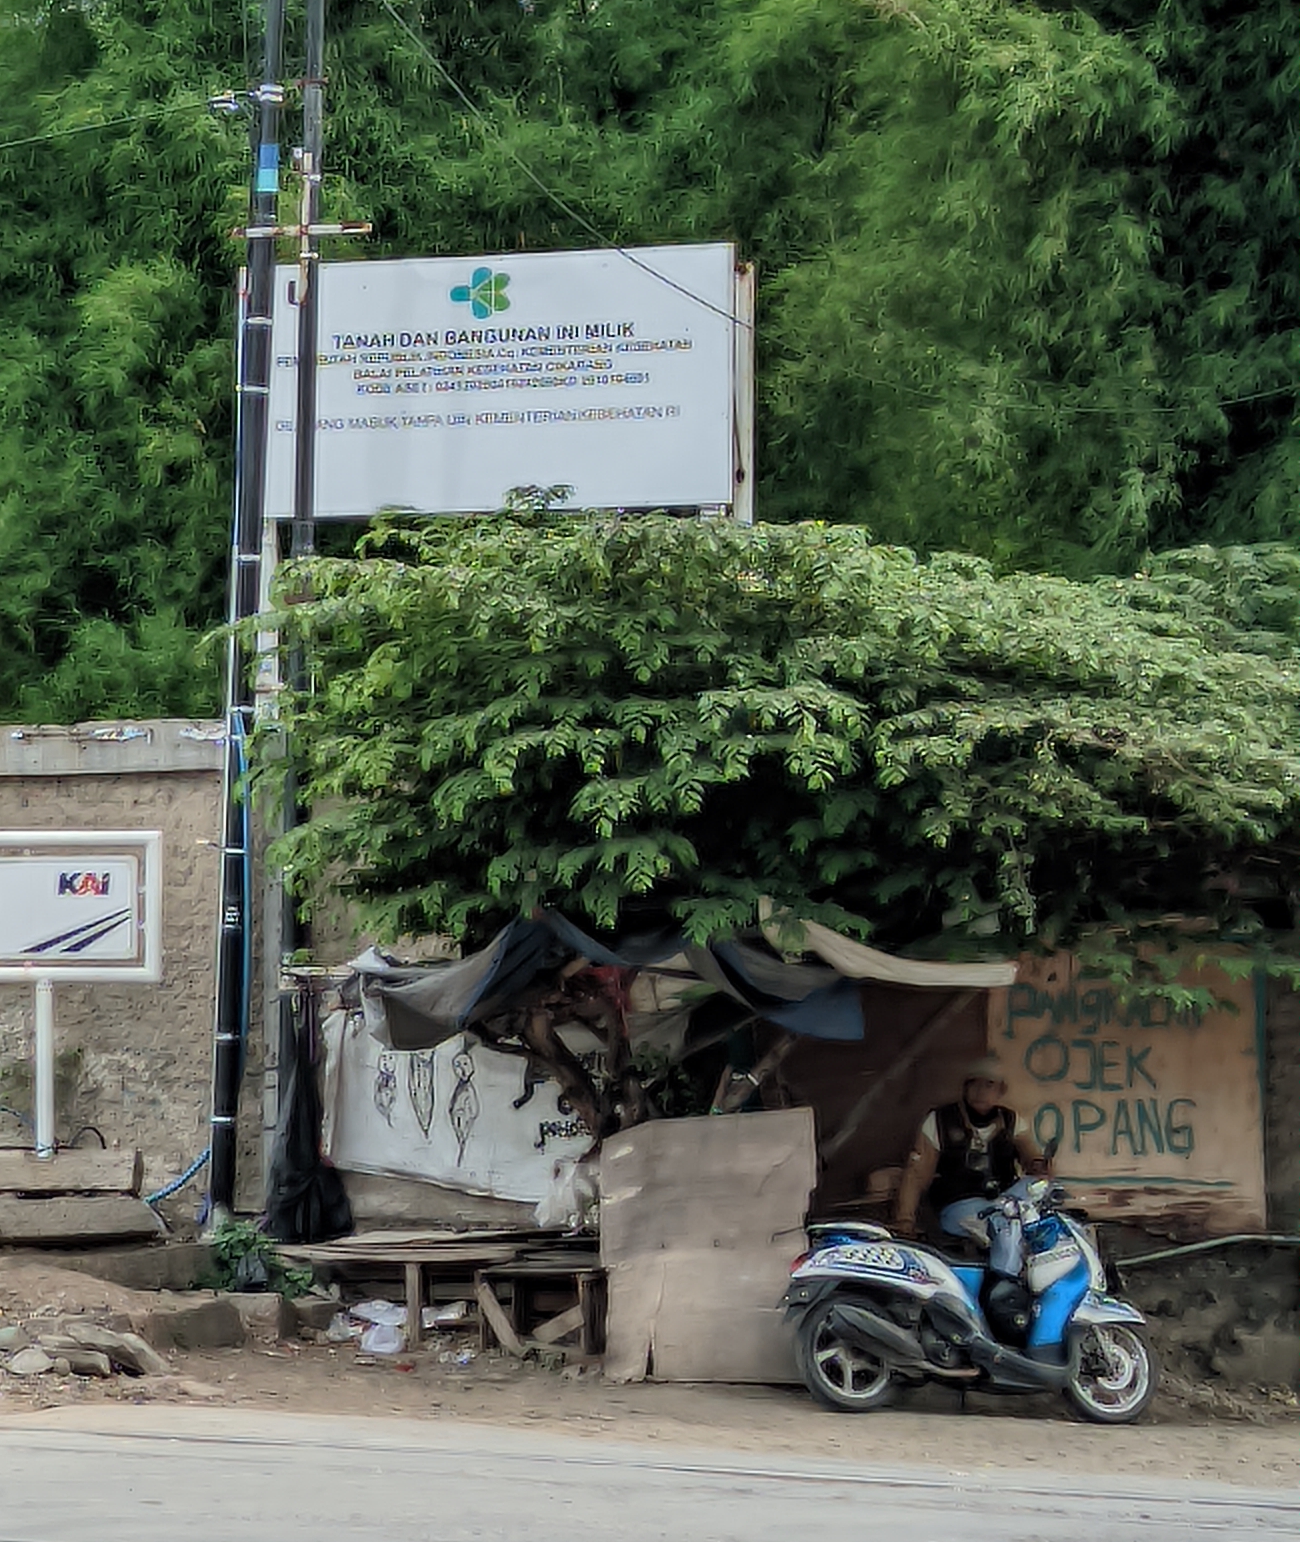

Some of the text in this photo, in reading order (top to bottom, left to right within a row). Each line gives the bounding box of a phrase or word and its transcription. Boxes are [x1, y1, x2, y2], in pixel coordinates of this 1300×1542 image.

[331, 322, 635, 350] TANAH DAN BANGUNAN INI MILIK
[58, 872, 110, 896] KAI
[1024, 1034, 1157, 1091] OJEK
[1033, 1098, 1197, 1157] OPANG
